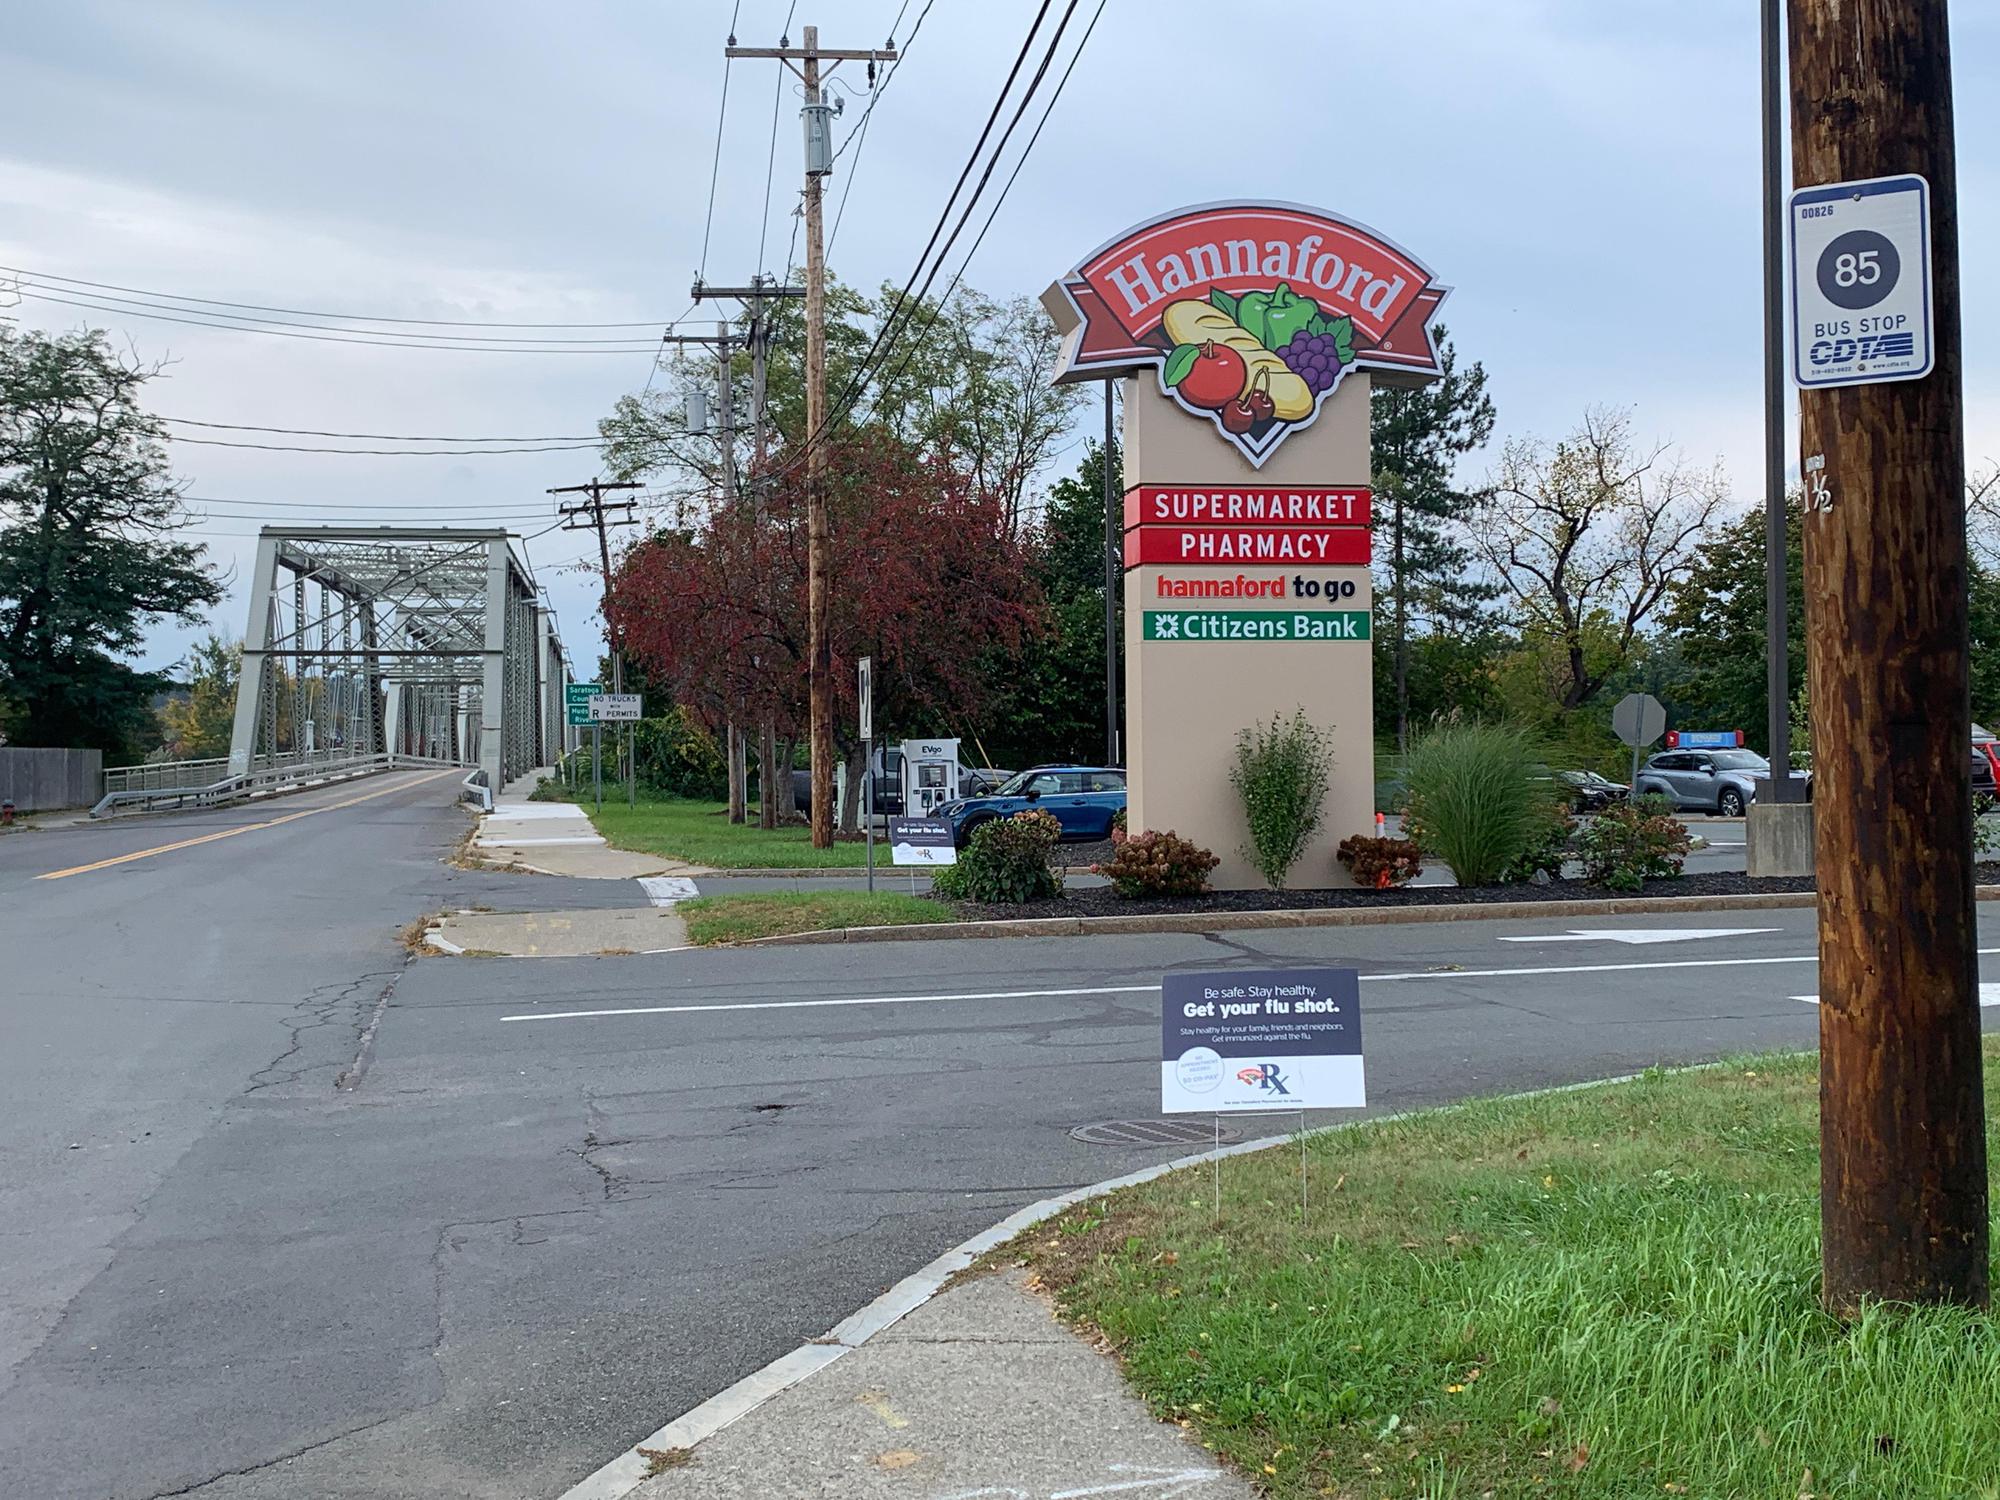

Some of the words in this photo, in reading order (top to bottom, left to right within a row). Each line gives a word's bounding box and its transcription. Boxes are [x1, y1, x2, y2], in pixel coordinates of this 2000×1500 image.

[1802, 205, 1834, 220] 00826
[1105, 235, 1407, 321] Hannaford
[1835, 250, 1881, 288] 85
[1814, 320, 1850, 338] BUS
[1860, 314, 1906, 332] STOP
[1810, 332, 1914, 365] CDTA
[1154, 494, 1356, 520] SUPERMARKET
[1180, 533, 1330, 558] PHARMACY
[1157, 574, 1286, 598] hannaford
[1184, 614, 1286, 638] Citizens
[1293, 614, 1357, 638] Bank
[592, 709, 600, 718] R
[922, 746, 942, 754] EVgo
[1204, 988, 1219, 999] Be
[1222, 987, 1246, 998] safe.
[1248, 986, 1273, 998] Stay
[1275, 985, 1317, 997] healthy.
[1184, 1001, 1215, 1018] Get
[1220, 1002, 1260, 1019] your
[1265, 999, 1290, 1014] flu
[1294, 998, 1340, 1014] shot.
[1180, 1028, 1196, 1036] Stay
[1196, 1026, 1220, 1035] healthy
[1225, 1034, 1262, 1042] immunized
